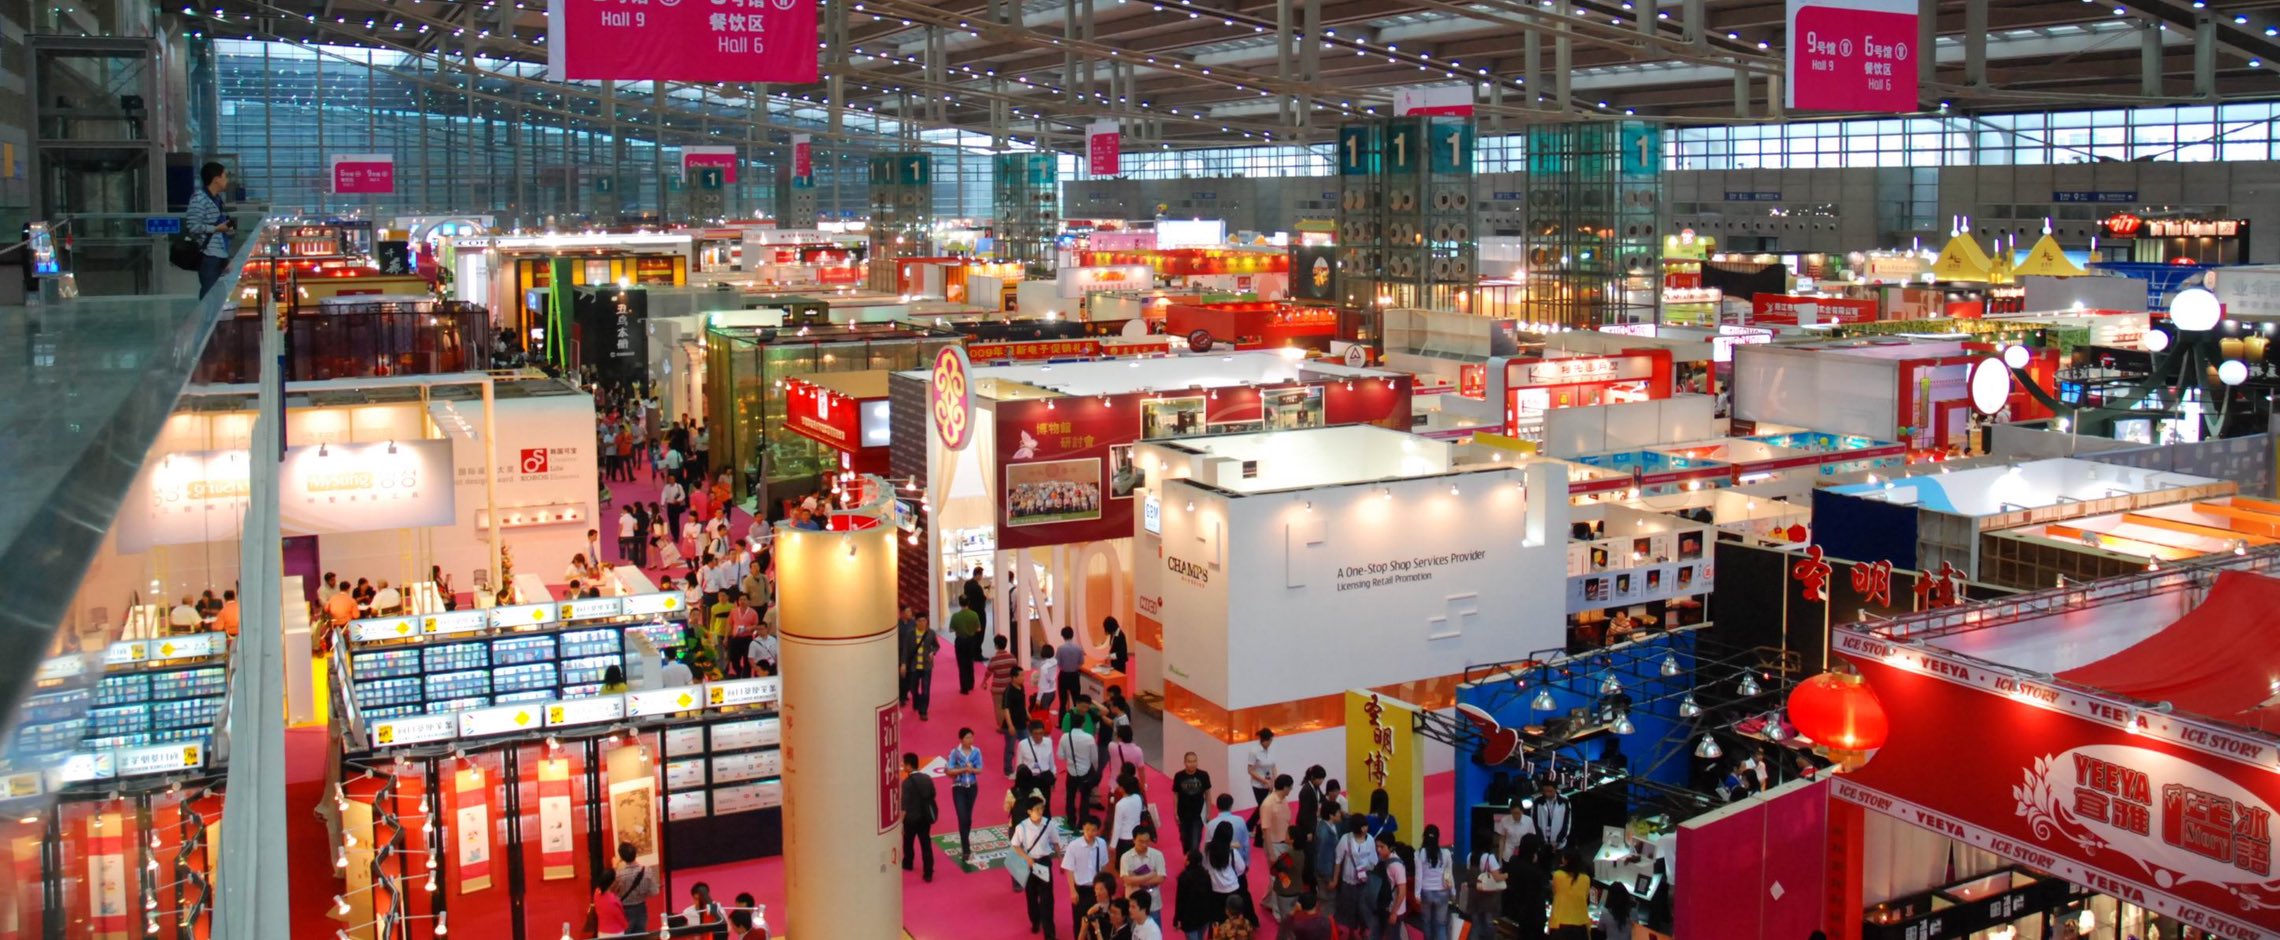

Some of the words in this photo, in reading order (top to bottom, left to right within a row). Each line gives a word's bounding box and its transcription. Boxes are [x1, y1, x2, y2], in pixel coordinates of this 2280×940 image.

[602, 12, 630, 27] Hall
[636, 13, 645, 27] 9
[710, 13, 764, 32] 餐饮区
[718, 37, 747, 53] Hall
[754, 37, 763, 54] 6
[1807, 31, 1836, 55] 9号馆
[1864, 35, 1892, 59] 6号馆
[1812, 60, 1826, 70] Hall
[1347, 135, 1357, 167] 1
[1394, 133, 1405, 166] 1
[1447, 132, 1460, 166] 1
[1636, 134, 1648, 167] 1
[708, 172, 716, 187] 1
[885, 161, 891, 180] 1
[910, 161, 919, 180] 1
[1039, 161, 1047, 178] 1
[601, 179, 608, 190] 1
[1036, 422, 1071, 435] 博物館
[1060, 435, 1094, 448] 研討會
[1168, 556, 1209, 583] CHAMPS
[1337, 567, 1344, 579] A
[1346, 561, 1388, 578] One-Stop
[1390, 559, 1412, 572] Shop
[1413, 554, 1449, 569] Services
[1451, 549, 1486, 563] Provider
[1337, 577, 1371, 592] Licensing
[1372, 574, 1394, 587] Retail
[1395, 571, 1433, 584] Promotion
[1843, 636, 1861, 651] ICE
[1921, 657, 1970, 681] YEEYA
[2180, 727, 2208, 745] ICE
[2208, 734, 2263, 759] STORY
[2073, 752, 2153, 806] YEEYA
[2073, 787, 2150, 837] 宜雅
[2234, 801, 2271, 877] 冰語
[1839, 784, 1857, 799] ICE
[1858, 790, 1893, 811] STORY
[1915, 810, 1966, 838] YEEYA
[1990, 838, 2012, 854] ICE
[2013, 845, 2056, 870] STORY
[2084, 870, 2145, 904] YEEYA
[2176, 905, 2204, 926] ICE
